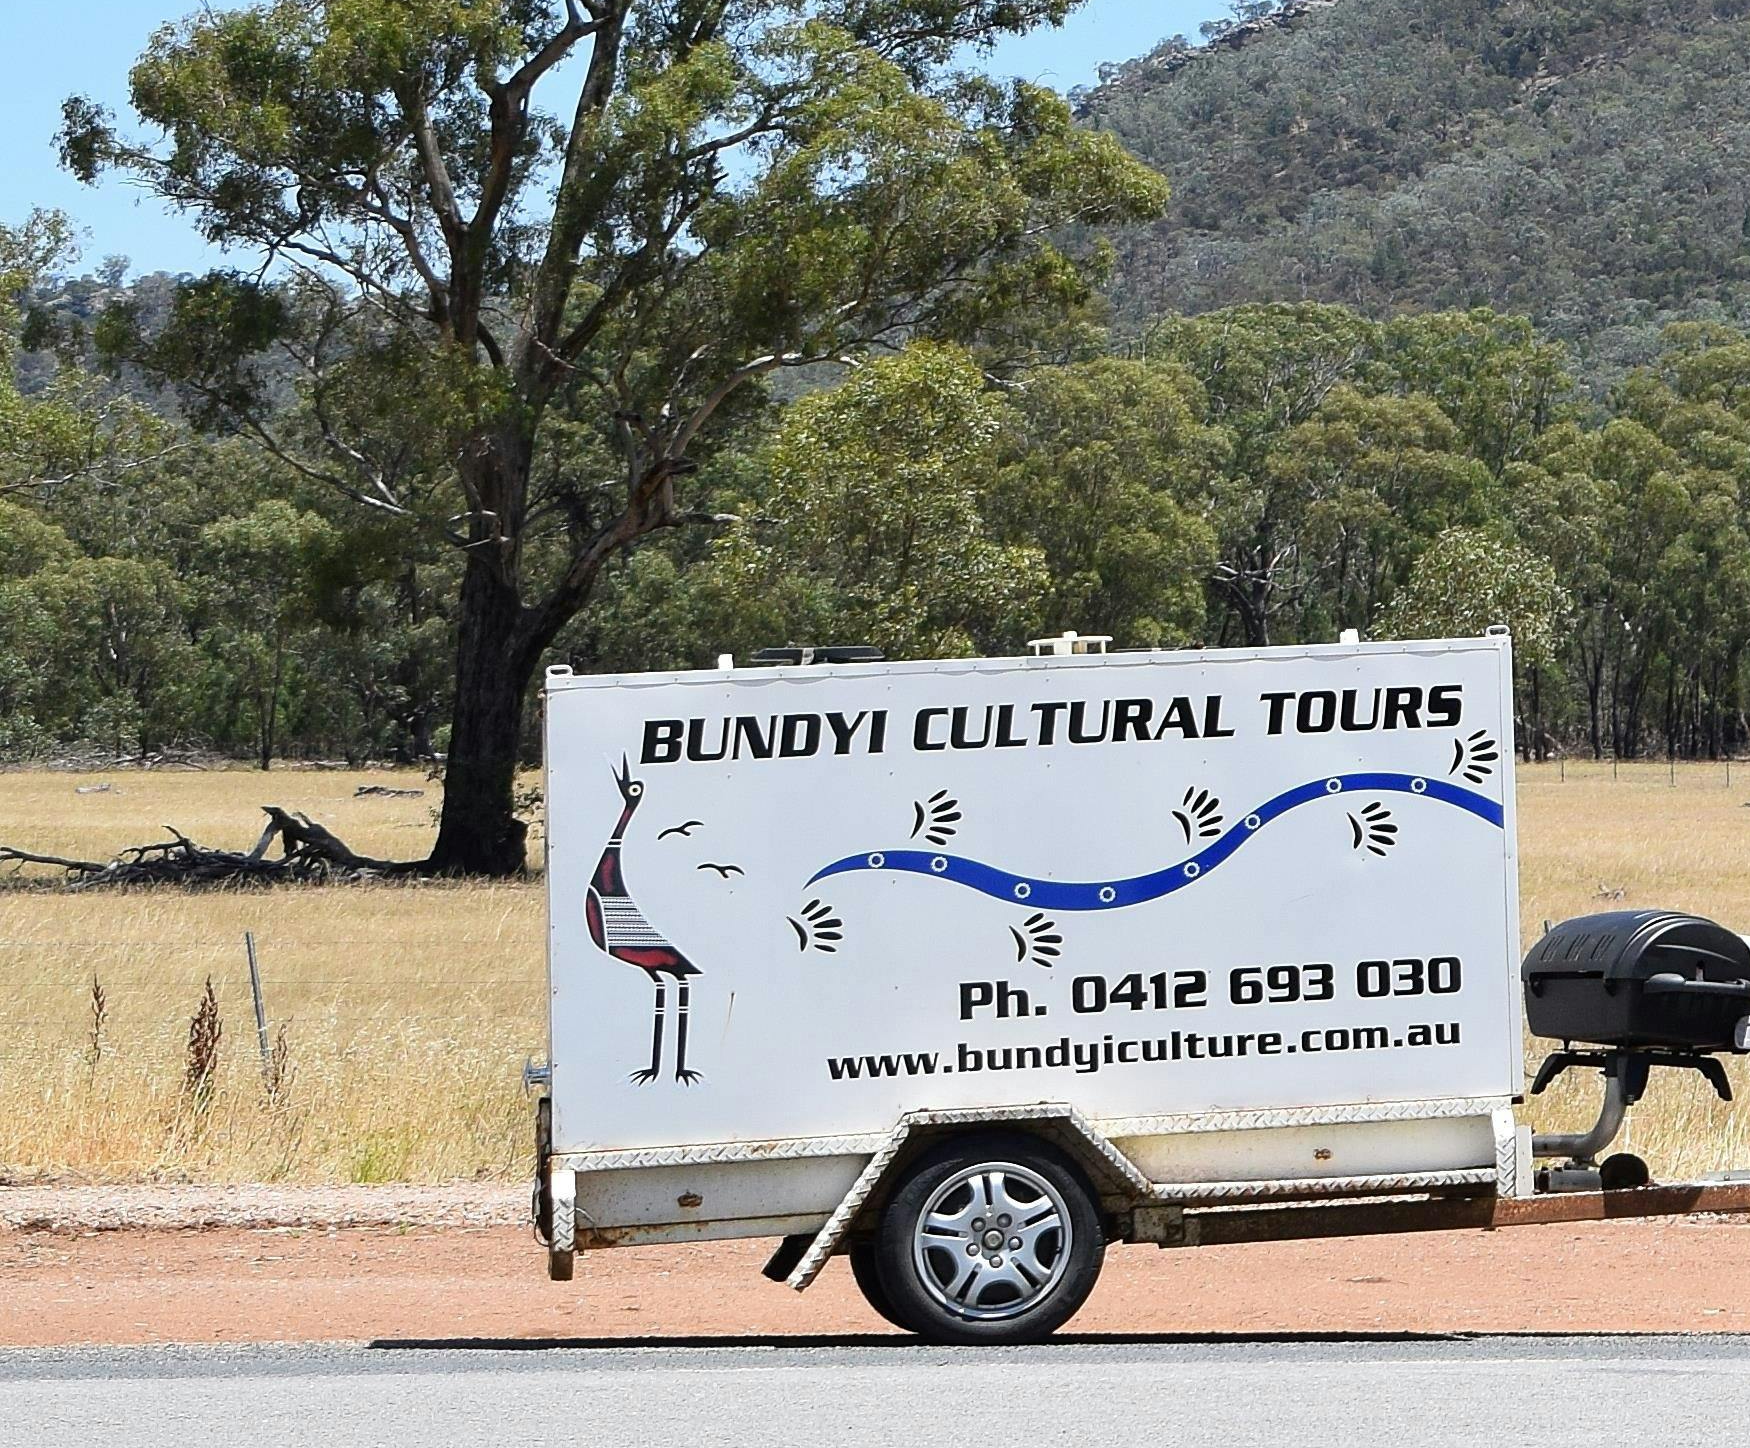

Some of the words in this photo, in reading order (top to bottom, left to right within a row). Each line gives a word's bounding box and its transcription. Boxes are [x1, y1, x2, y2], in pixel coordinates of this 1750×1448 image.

[639, 709, 889, 766] BUNDYI
[912, 694, 1237, 750] CULTURAL
[1259, 683, 1464, 737] TOURS
[959, 977, 1048, 1022] Ph.
[1071, 969, 1208, 1015] 0412
[1228, 963, 1335, 1006] 693
[1355, 956, 1463, 998] 030
[827, 1021, 1461, 1080] www.bundyiculture.com.au
